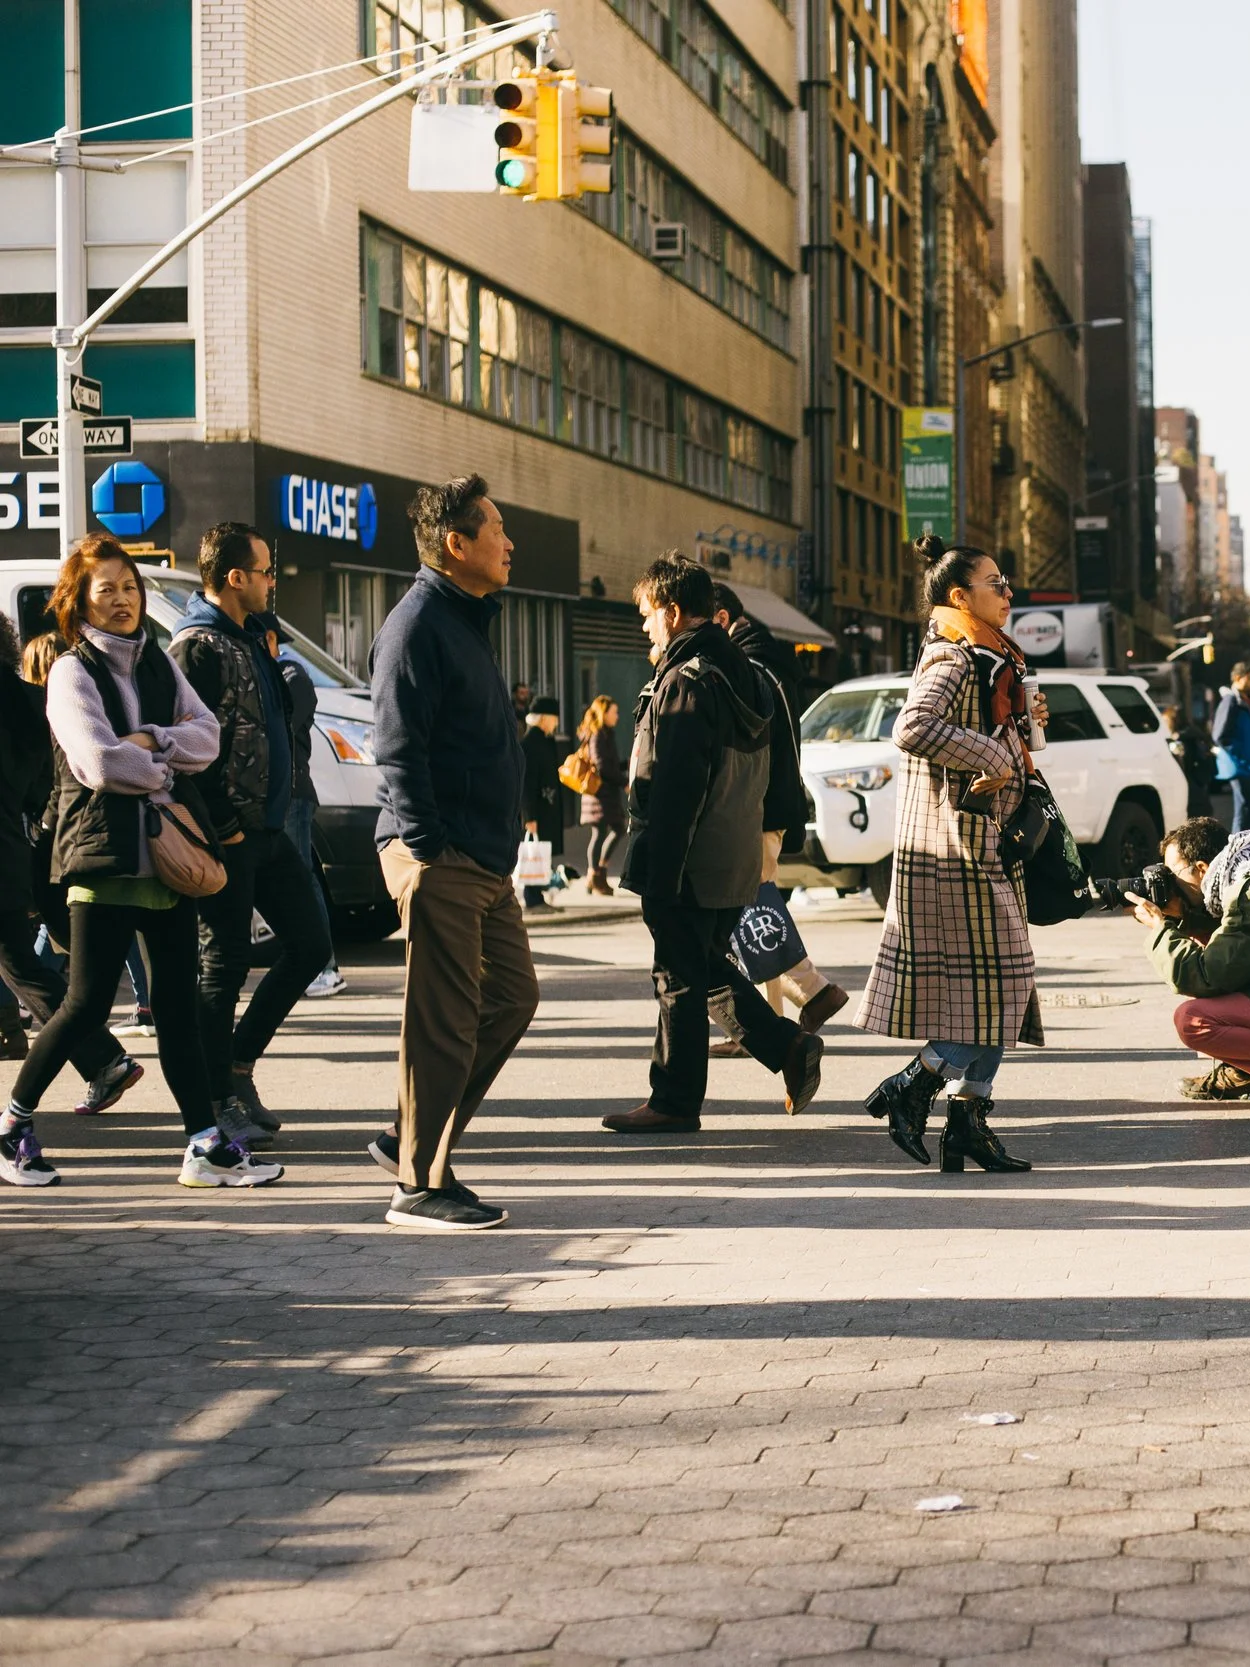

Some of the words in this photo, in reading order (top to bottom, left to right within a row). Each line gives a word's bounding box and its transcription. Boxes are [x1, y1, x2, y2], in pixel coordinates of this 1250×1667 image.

[38, 432, 58, 445] ON
[84, 430, 117, 443] WAY
[905, 463, 949, 489] UNION
[288, 474, 358, 541] CHASE
[740, 908, 756, 927] HEALTH
[762, 905, 785, 925] RACQUET
[739, 928, 748, 945] YORK
[746, 944, 760, 955] NEW
